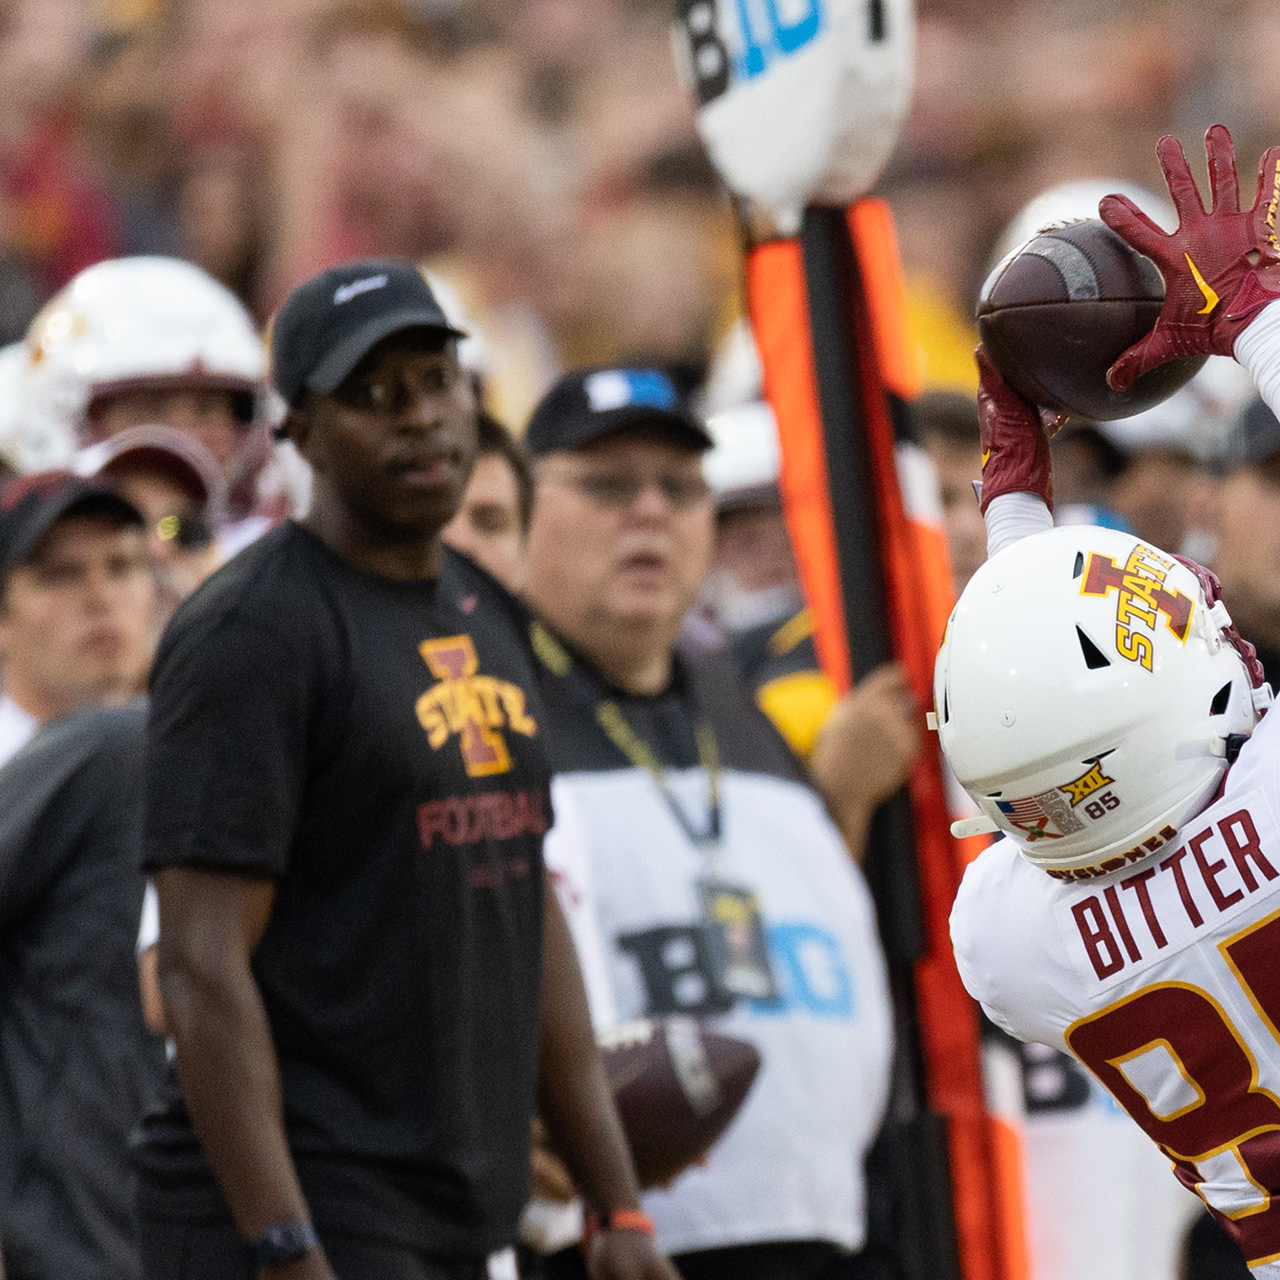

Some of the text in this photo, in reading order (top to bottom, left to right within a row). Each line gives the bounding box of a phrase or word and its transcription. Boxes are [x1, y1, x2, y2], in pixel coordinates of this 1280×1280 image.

[1116, 544, 1175, 673] STATE
[415, 675, 537, 751] STATE
[416, 791, 549, 851] FOOTBA
[1057, 761, 1115, 807] XII
[1084, 791, 1120, 820] 85
[1071, 809, 1280, 981] BITTER
[614, 922, 857, 1018] BG
